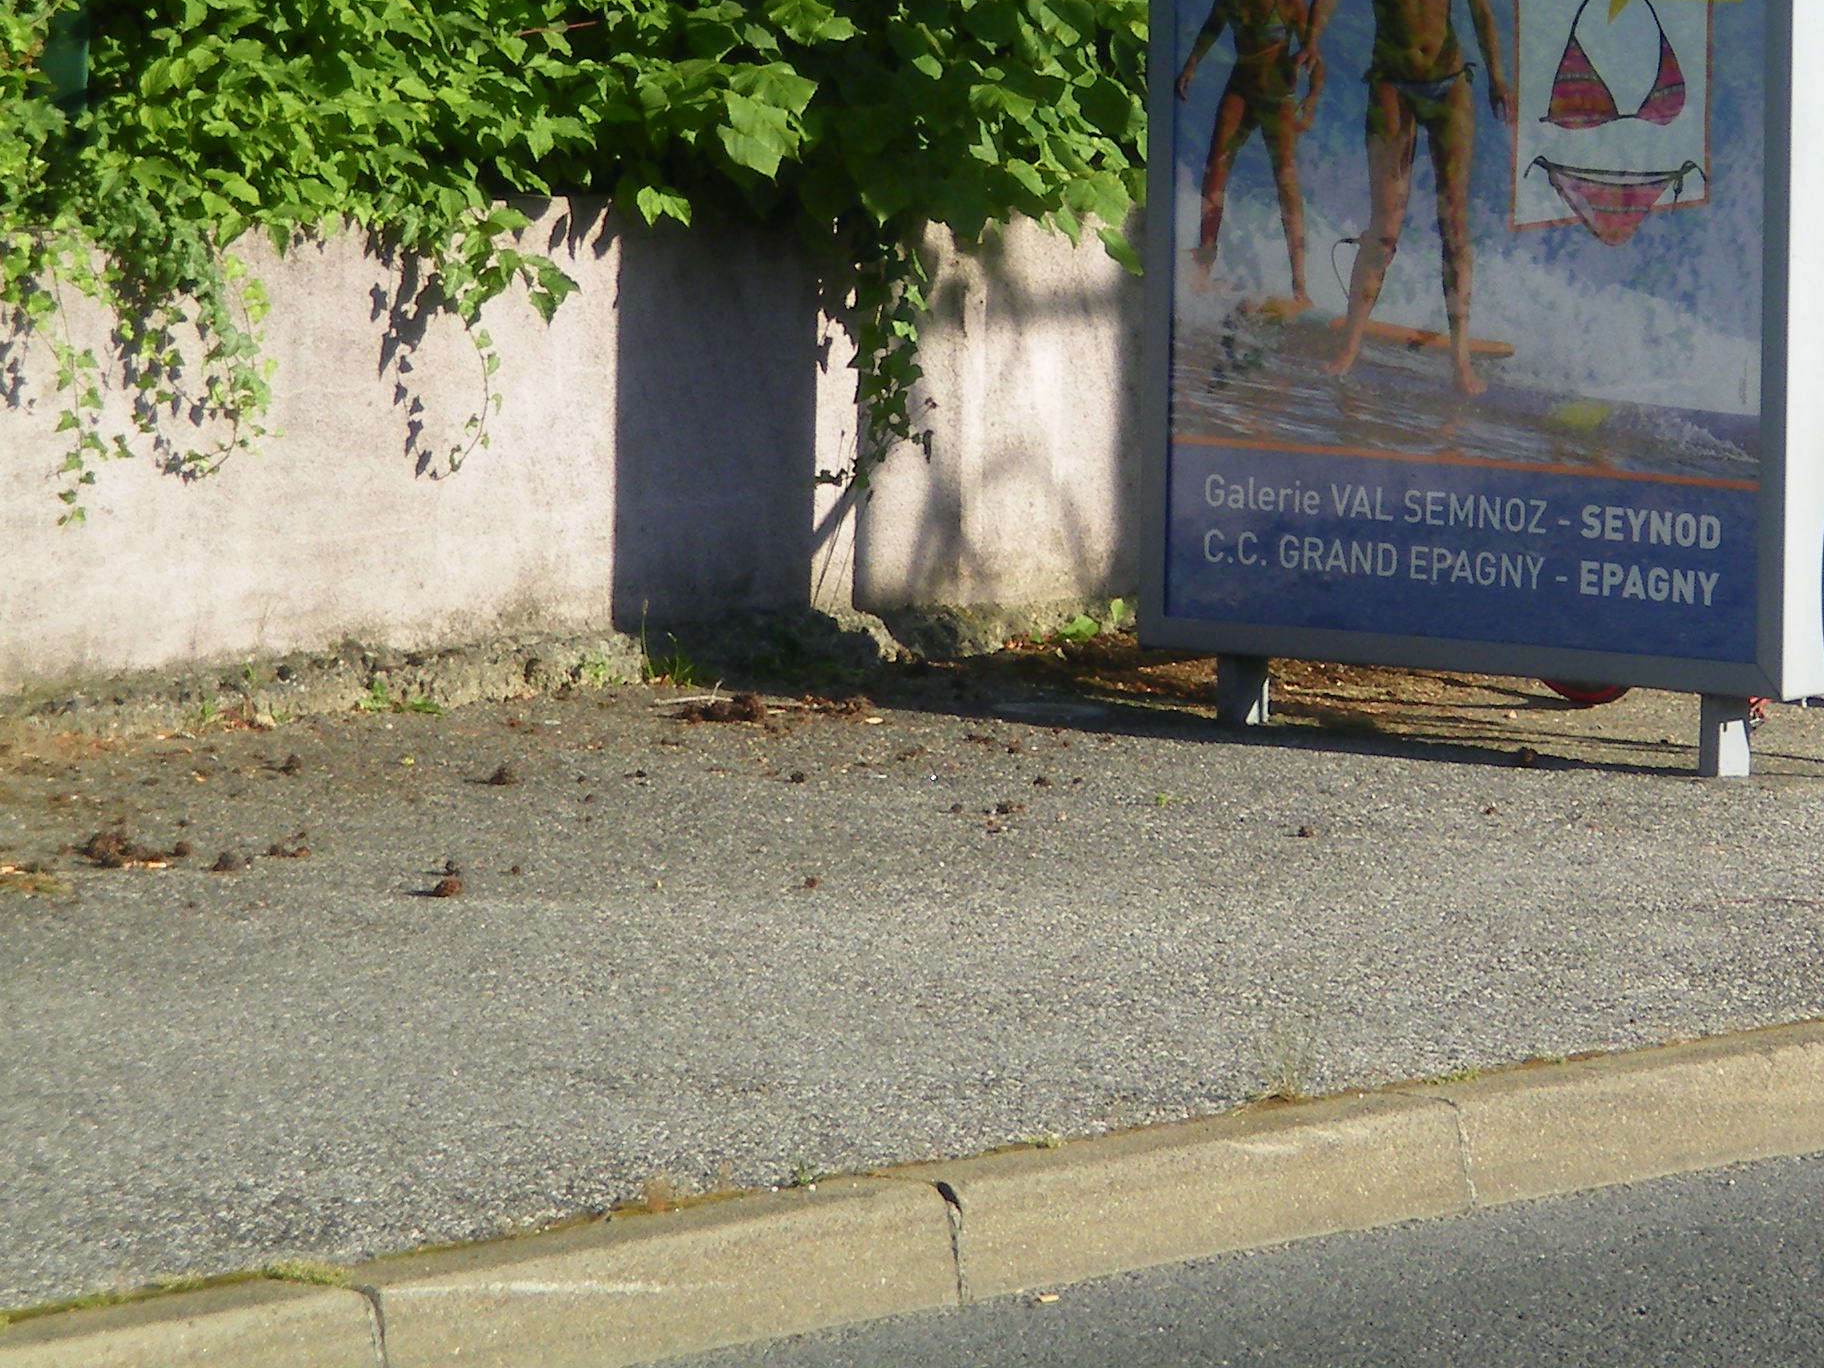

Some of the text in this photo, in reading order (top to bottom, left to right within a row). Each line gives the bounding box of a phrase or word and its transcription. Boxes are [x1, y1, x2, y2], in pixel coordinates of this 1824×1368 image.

[1204, 474, 1321, 516] Galerie
[1331, 484, 1393, 522] VAL
[1404, 489, 1548, 534] SEMNOZ
[1580, 504, 1721, 550] SEYNOD
[1203, 530, 1268, 569] C.C.
[1278, 534, 1399, 578] GRAND
[1410, 545, 1545, 590] EPAGNY
[1578, 560, 1720, 606] EPAGNY
